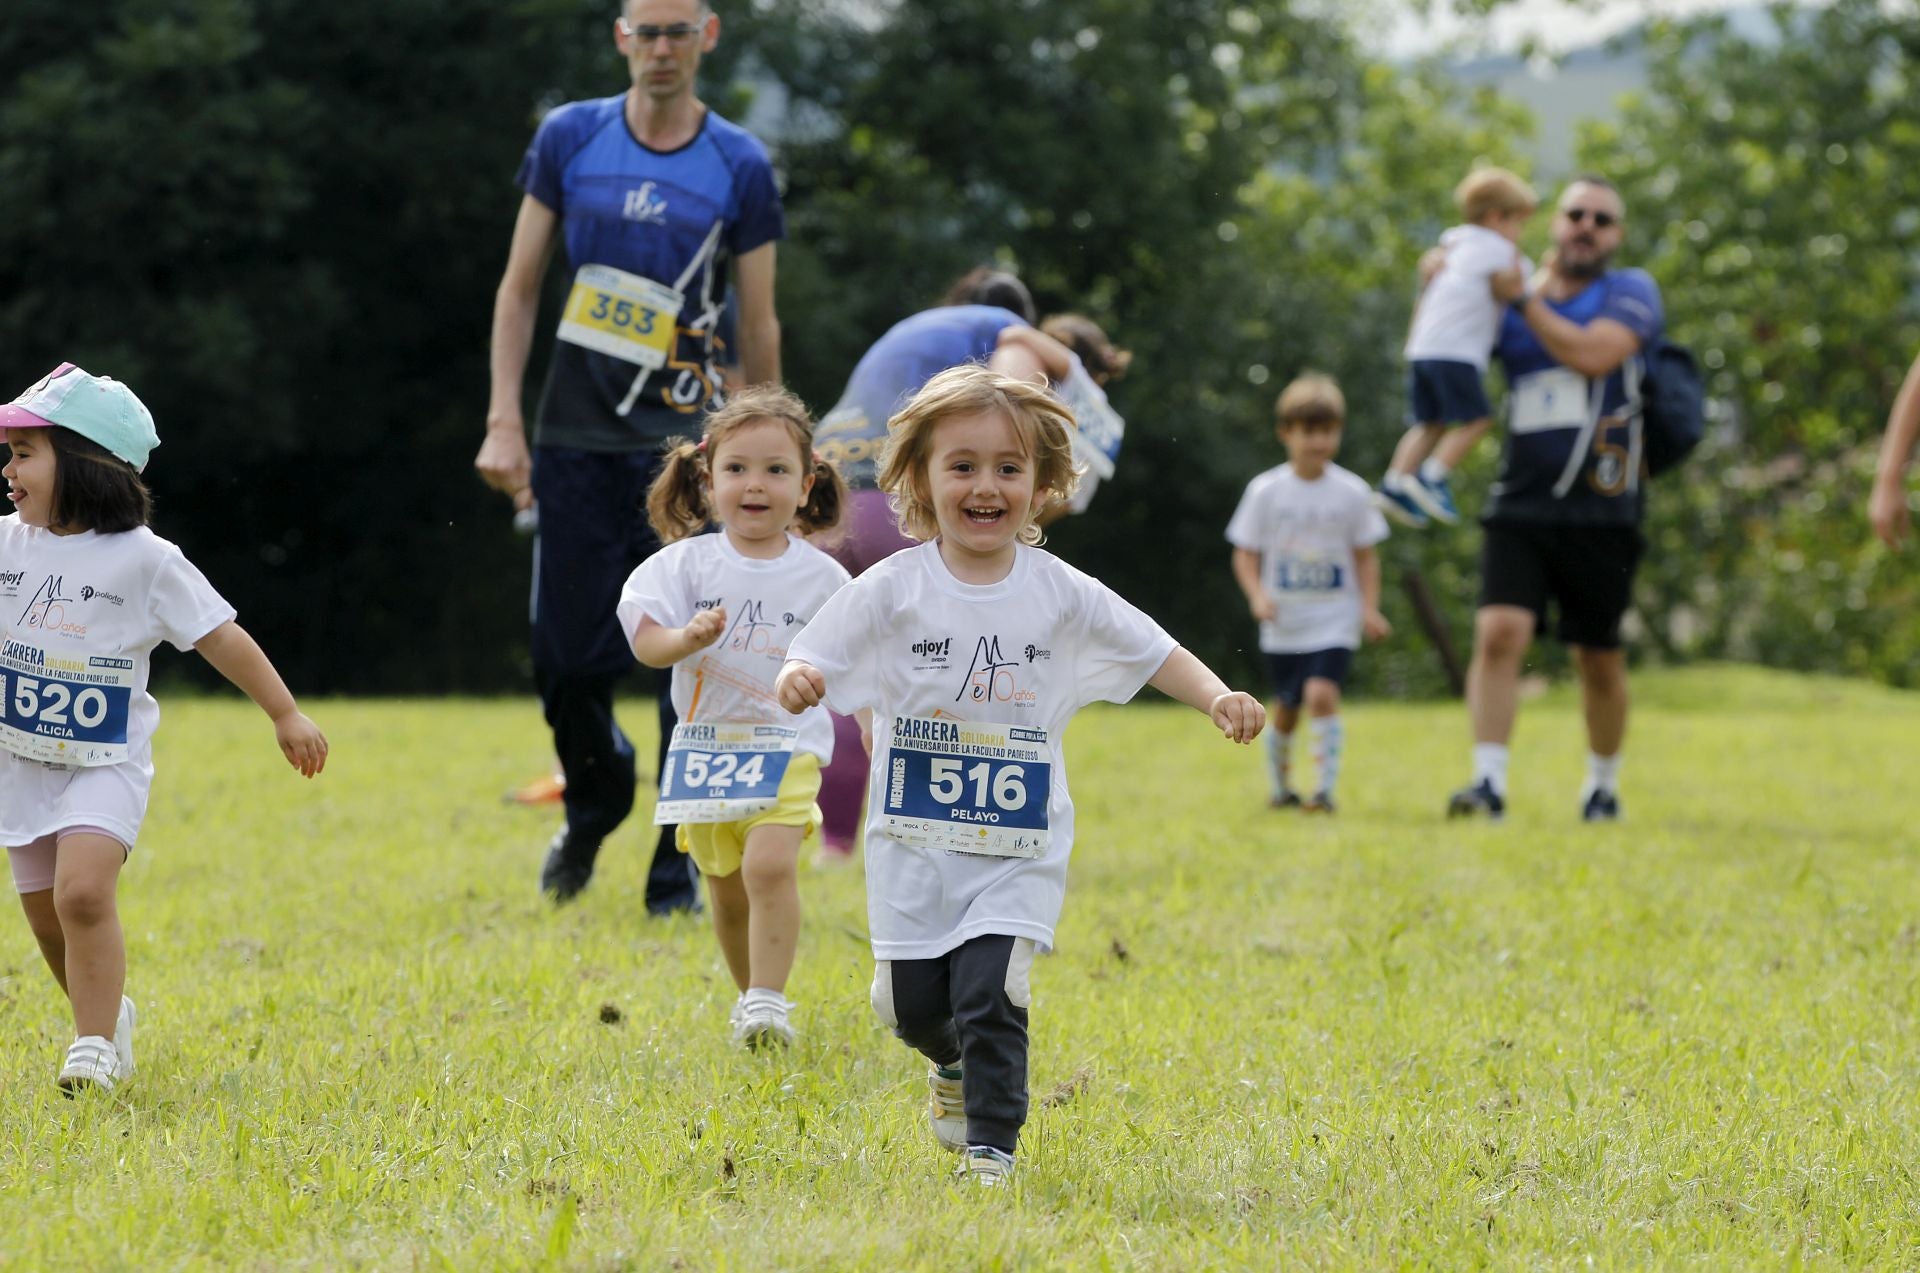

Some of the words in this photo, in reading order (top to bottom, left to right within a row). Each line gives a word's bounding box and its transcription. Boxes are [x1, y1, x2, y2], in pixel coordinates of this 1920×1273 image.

[590, 293, 657, 336] 353
[0, 570, 25, 586] njoy!
[2, 640, 45, 666] CARRERA
[912, 637, 950, 657] enjoy!
[6, 659, 36, 674] ANIVERSARIO
[37, 667, 45, 675] DE
[45, 669, 54, 677] LA
[54, 669, 85, 681] FACULTAD
[15, 676, 108, 728] 520
[35, 723, 74, 738] ALICIA
[895, 717, 959, 743] CARRERA
[960, 731, 1005, 747] SOLIDARIA
[893, 736, 903, 747] 50
[904, 739, 949, 753] ANIVERSARIO
[950, 743, 960, 754] DE
[961, 745, 970, 755] LA
[972, 746, 1005, 758] FACULTAD
[683, 752, 765, 788] 524
[709, 786, 726, 798] LÍA
[890, 757, 906, 809] MENORES
[929, 757, 1027, 811] 516
[951, 808, 1000, 823] PELAYO
